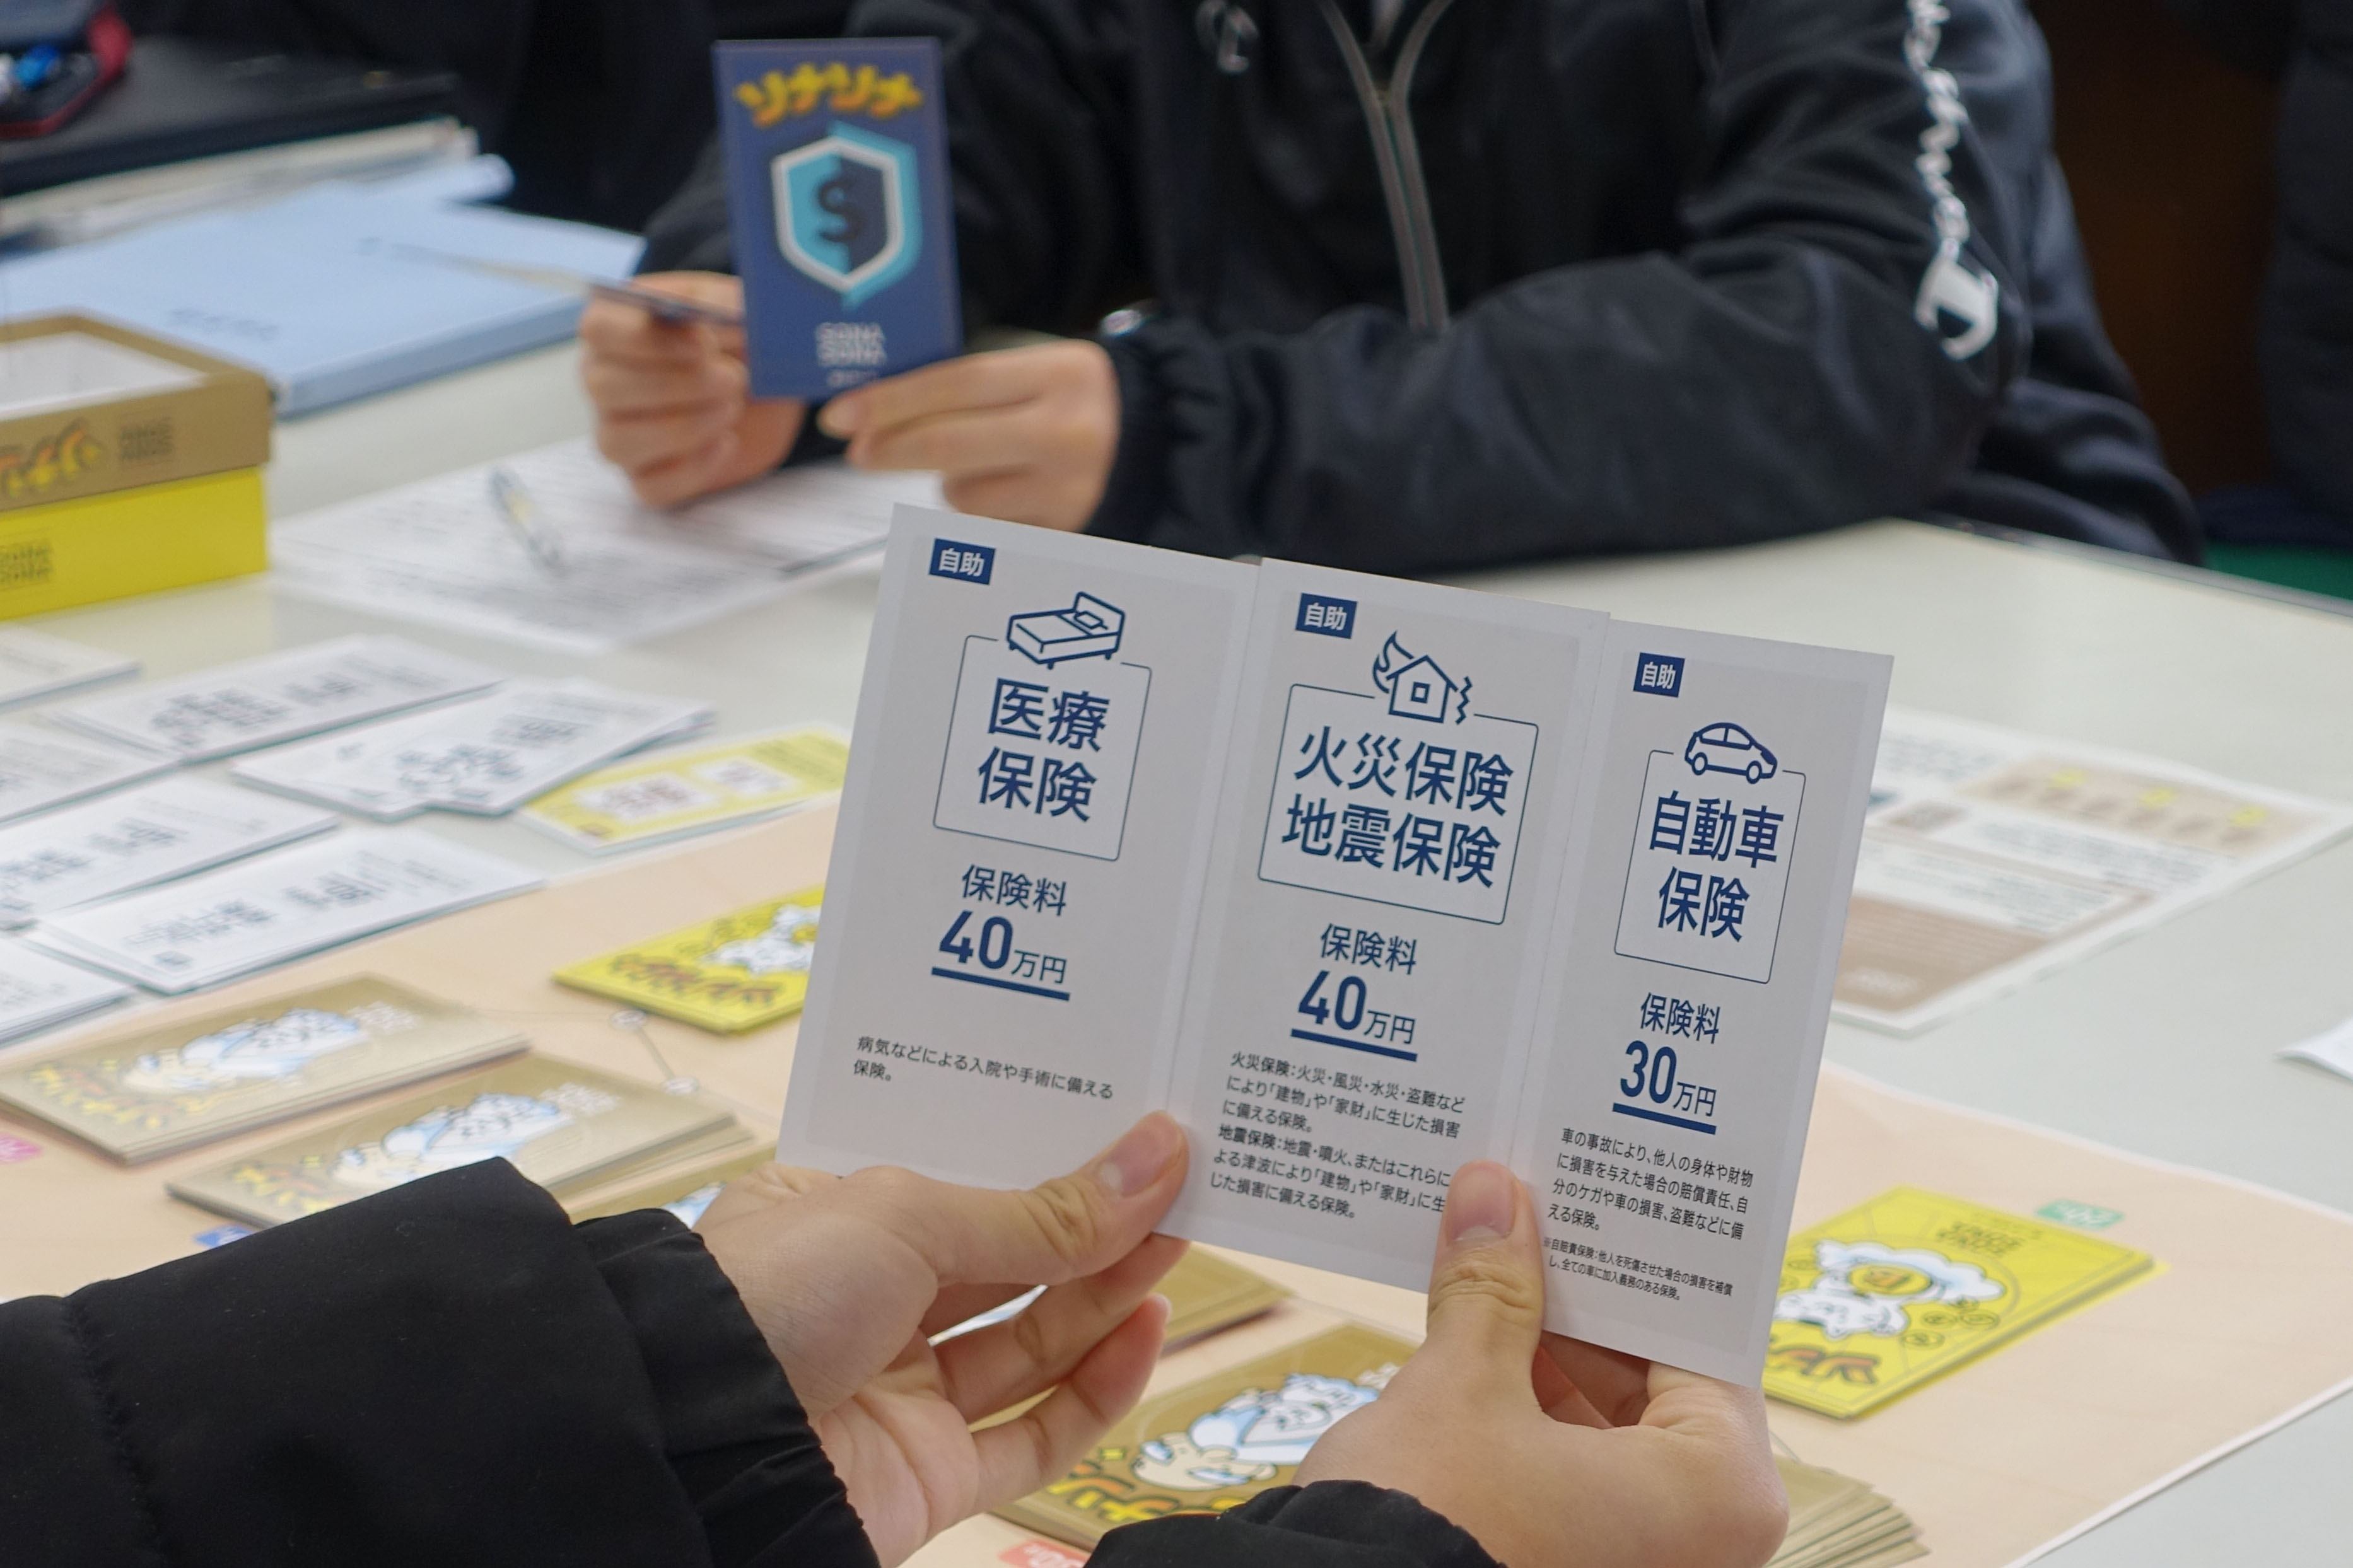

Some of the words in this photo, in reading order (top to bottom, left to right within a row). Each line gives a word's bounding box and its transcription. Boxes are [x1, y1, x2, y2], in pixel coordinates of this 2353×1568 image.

[938, 549, 984, 577] 自助
[1304, 602, 1347, 630] 自助
[1641, 661, 1676, 689] 自助
[987, 678, 1110, 752] 医療
[978, 746, 1097, 823] 保険
[1293, 726, 1514, 816] 火災保険
[1282, 793, 1502, 888] 地震保険
[1649, 790, 1784, 869] 自動車
[962, 864, 1066, 917] 保険料
[1657, 866, 1750, 943] 保険
[938, 910, 1067, 984] 40万円
[1320, 923, 1417, 975] 保険料
[1298, 970, 1416, 1045] 40万円
[1640, 992, 1720, 1045] 保険料
[853, 1059, 891, 1081] 保険。
[857, 1036, 1113, 1100] 病気などによる入院や手術に備える
[1620, 1040, 1717, 1117] 30万円
[1222, 1100, 1311, 1133] に備える保険。
[1556, 1153, 1748, 1214] に損害を与えた場合の賠償責任、自
[1562, 1128, 1754, 1188] 車の事故により、他人の身体や財物
[1210, 1171, 1355, 1219] じた損害に備える保険。
[1548, 1203, 1599, 1231] える保険。
[1553, 1178, 1744, 1240] 分のケガや車の損害、盗難などに備
